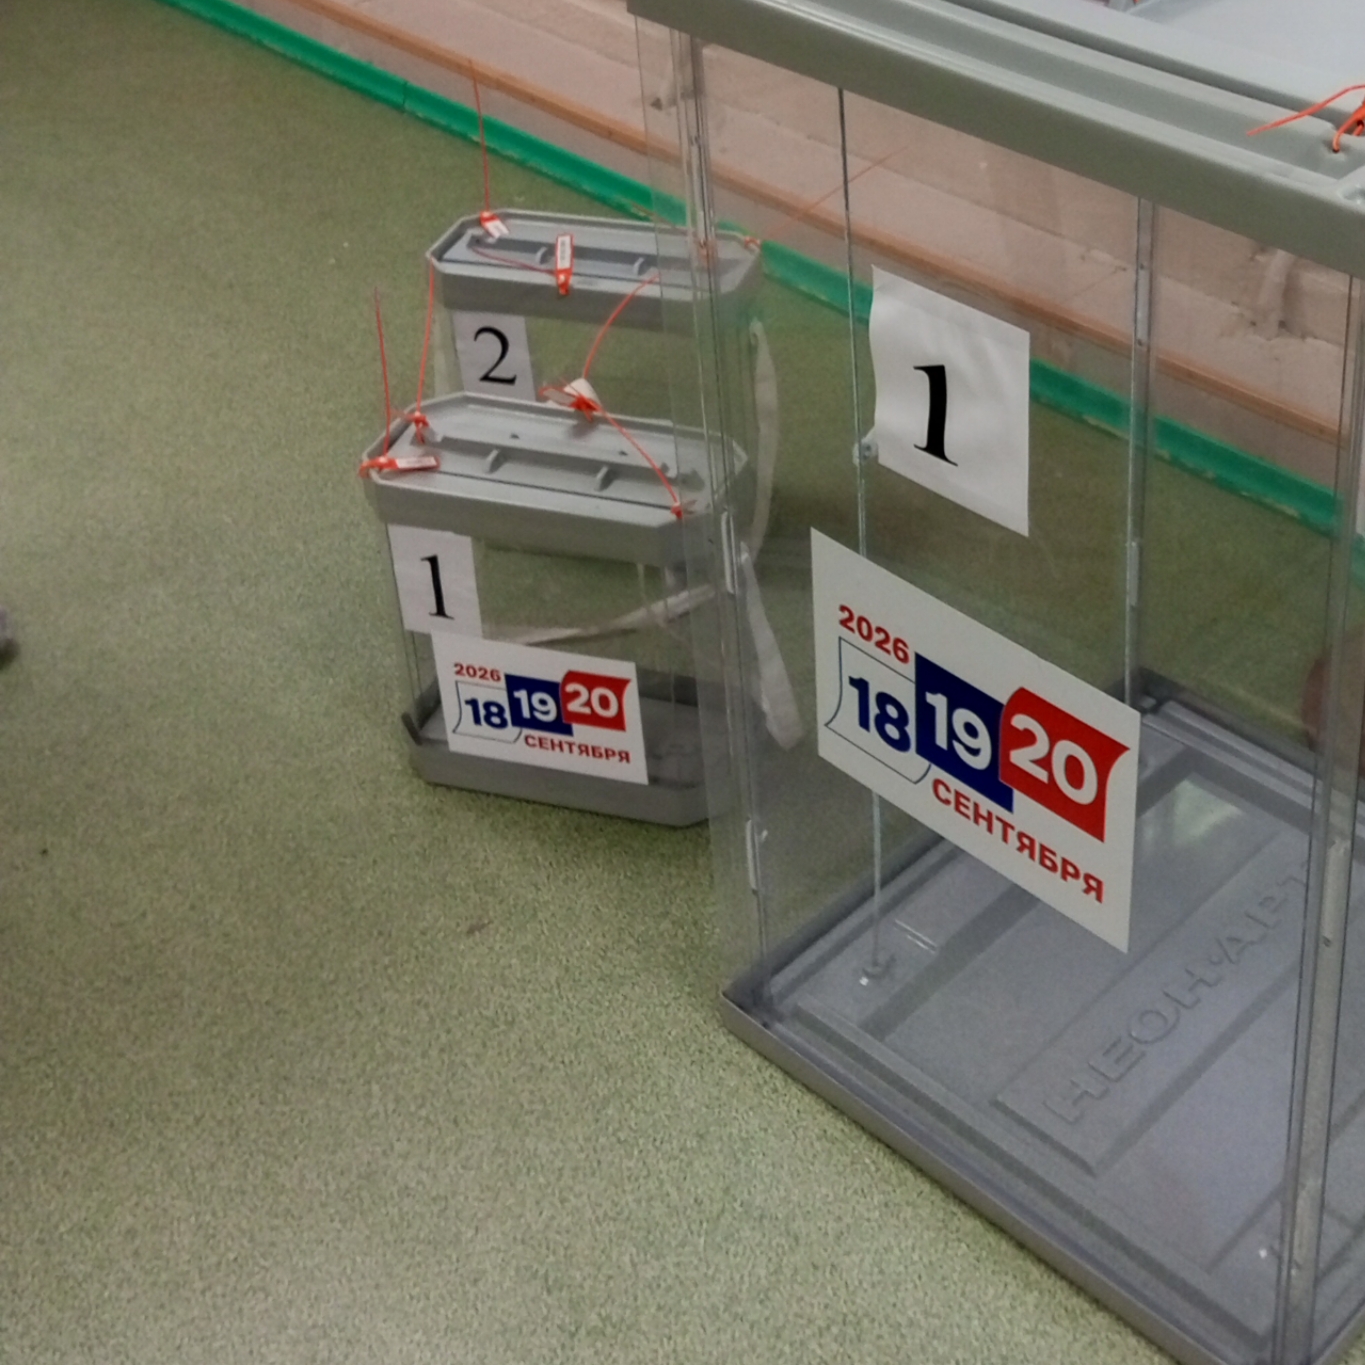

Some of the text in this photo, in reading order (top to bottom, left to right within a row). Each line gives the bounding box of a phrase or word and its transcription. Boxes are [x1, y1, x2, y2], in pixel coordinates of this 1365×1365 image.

[474, 326, 518, 386] 2
[912, 364, 958, 467] 1
[420, 555, 455, 620] 1
[838, 604, 910, 665] 2026
[454, 663, 502, 682] 2026
[465, 682, 619, 729] 18 19 20
[524, 734, 631, 764] СЕНТЯБРЯ
[848, 675, 1098, 806] 18 19 20
[931, 777, 1104, 904] СЕНТЯБРЯ
